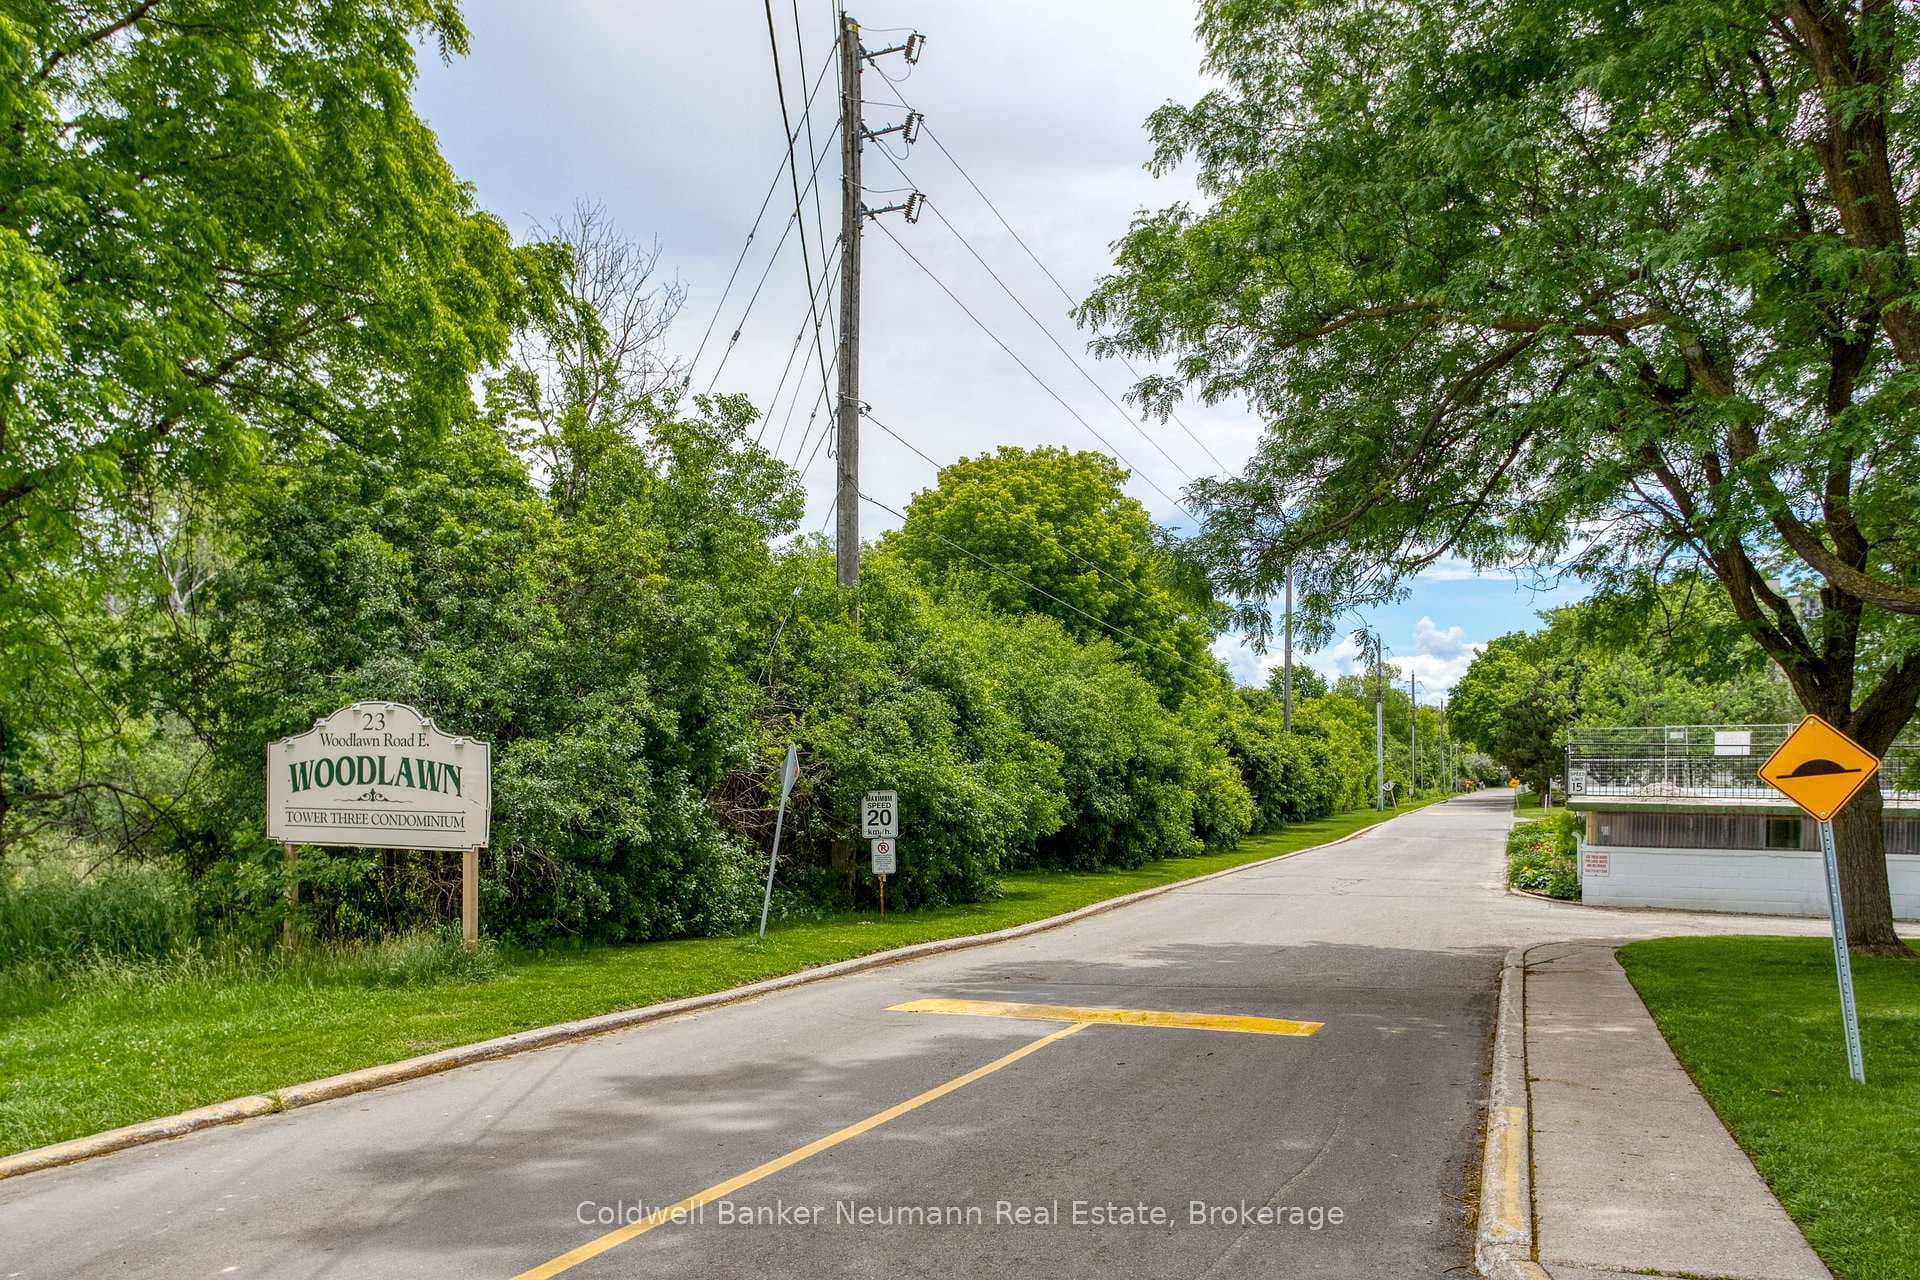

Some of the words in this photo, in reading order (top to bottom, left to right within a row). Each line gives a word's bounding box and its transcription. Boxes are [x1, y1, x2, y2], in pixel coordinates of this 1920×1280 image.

[362, 713, 385, 731] 23
[320, 732, 380, 747] Woodlawn
[384, 733, 415, 747] Road
[418, 733, 430, 747] E.
[289, 755, 463, 798] WOODLAWN
[1572, 782, 1583, 792] 15
[286, 810, 328, 824] TOWER
[330, 812, 369, 826] THREE
[371, 813, 465, 828] CONDOMINIUM
[867, 809, 892, 826] 20
